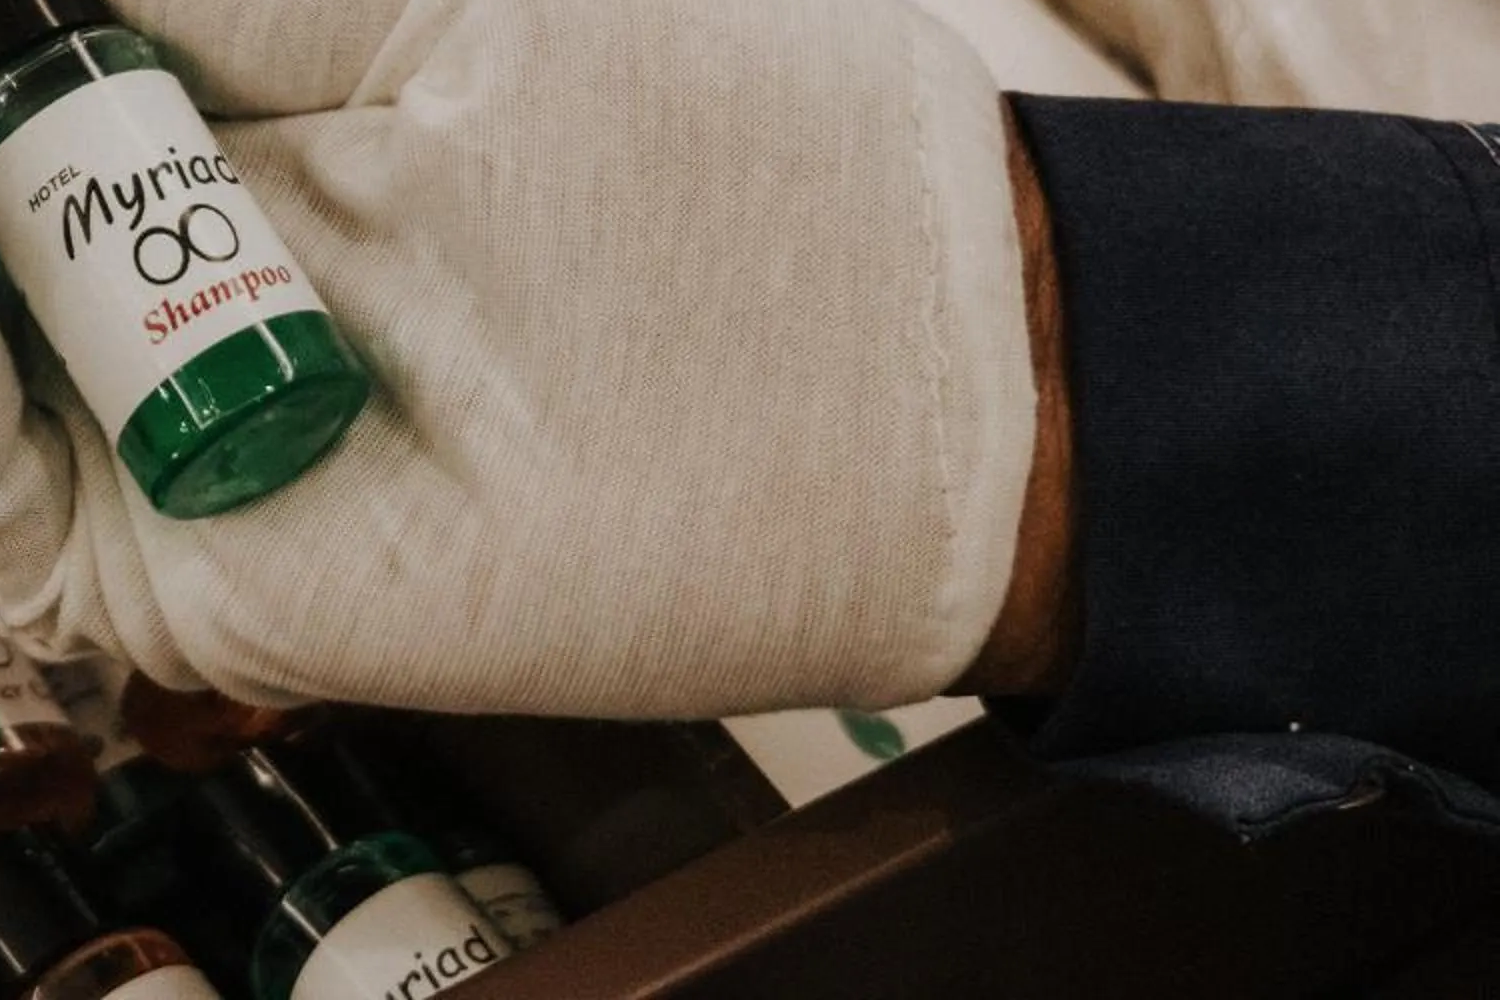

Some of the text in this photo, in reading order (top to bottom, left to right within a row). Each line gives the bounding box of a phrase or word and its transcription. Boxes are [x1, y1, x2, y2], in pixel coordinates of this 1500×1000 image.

[28, 164, 82, 213] HOTEL
[143, 263, 293, 346] Shampoo
[384, 922, 498, 1000] riad
